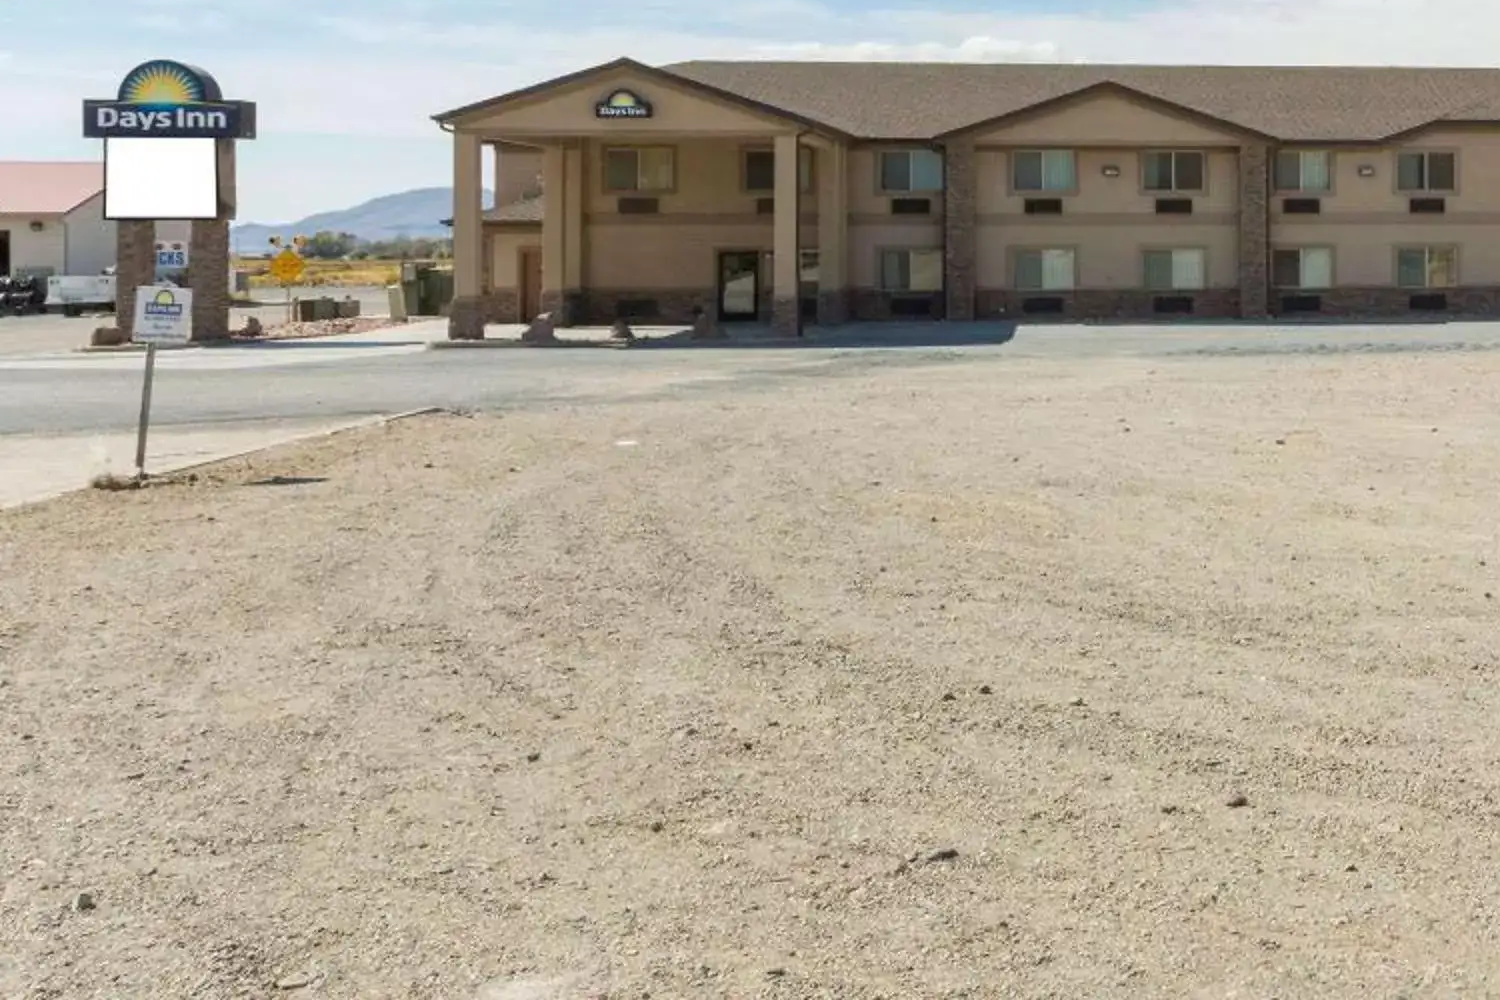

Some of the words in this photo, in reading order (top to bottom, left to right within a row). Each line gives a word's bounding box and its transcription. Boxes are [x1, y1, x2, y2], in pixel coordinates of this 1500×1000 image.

[97, 107, 171, 131] Days
[176, 107, 227, 129] Inn
[158, 251, 185, 266] CKS
